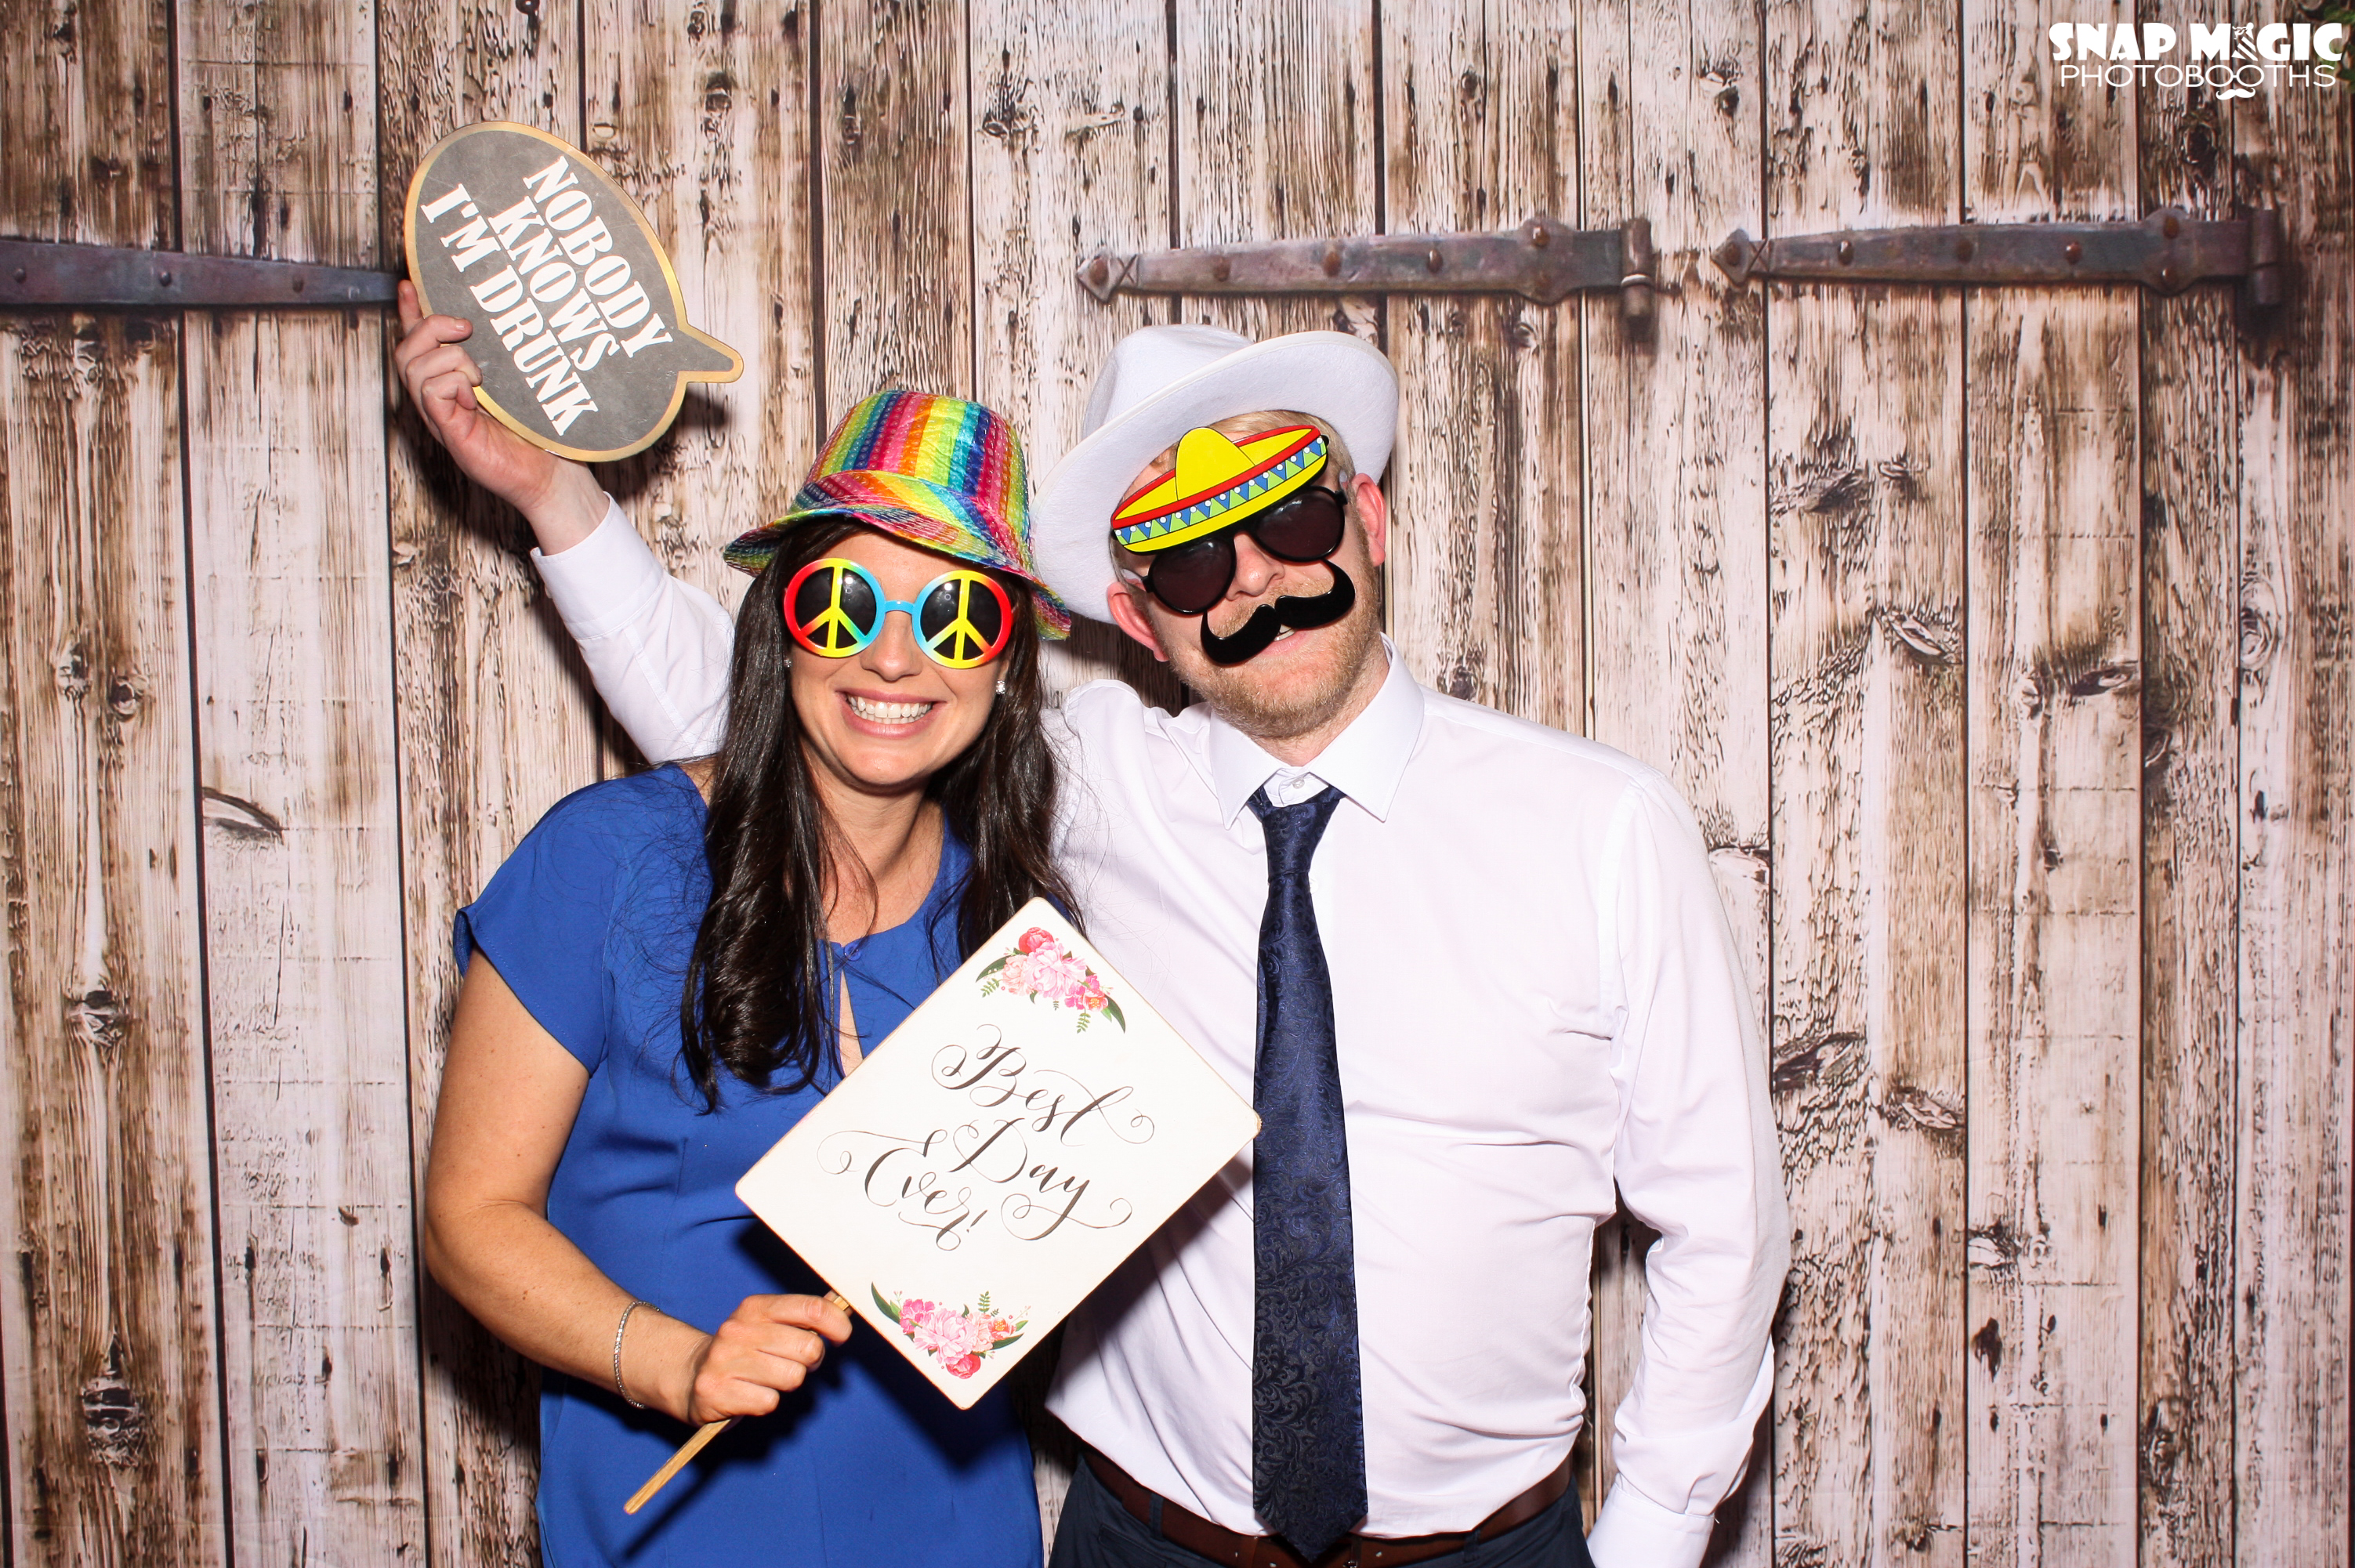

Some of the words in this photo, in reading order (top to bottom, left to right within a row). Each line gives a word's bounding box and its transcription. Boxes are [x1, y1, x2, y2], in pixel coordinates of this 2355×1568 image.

[420, 183, 501, 272] I'M
[469, 265, 598, 436] DRUNK
[488, 196, 620, 371] KNOWS
[523, 156, 673, 357] NOBODY
[932, 1024, 1154, 1146] Best
[817, 1129, 987, 1251] Ever!
[946, 1117, 1132, 1240] Day
